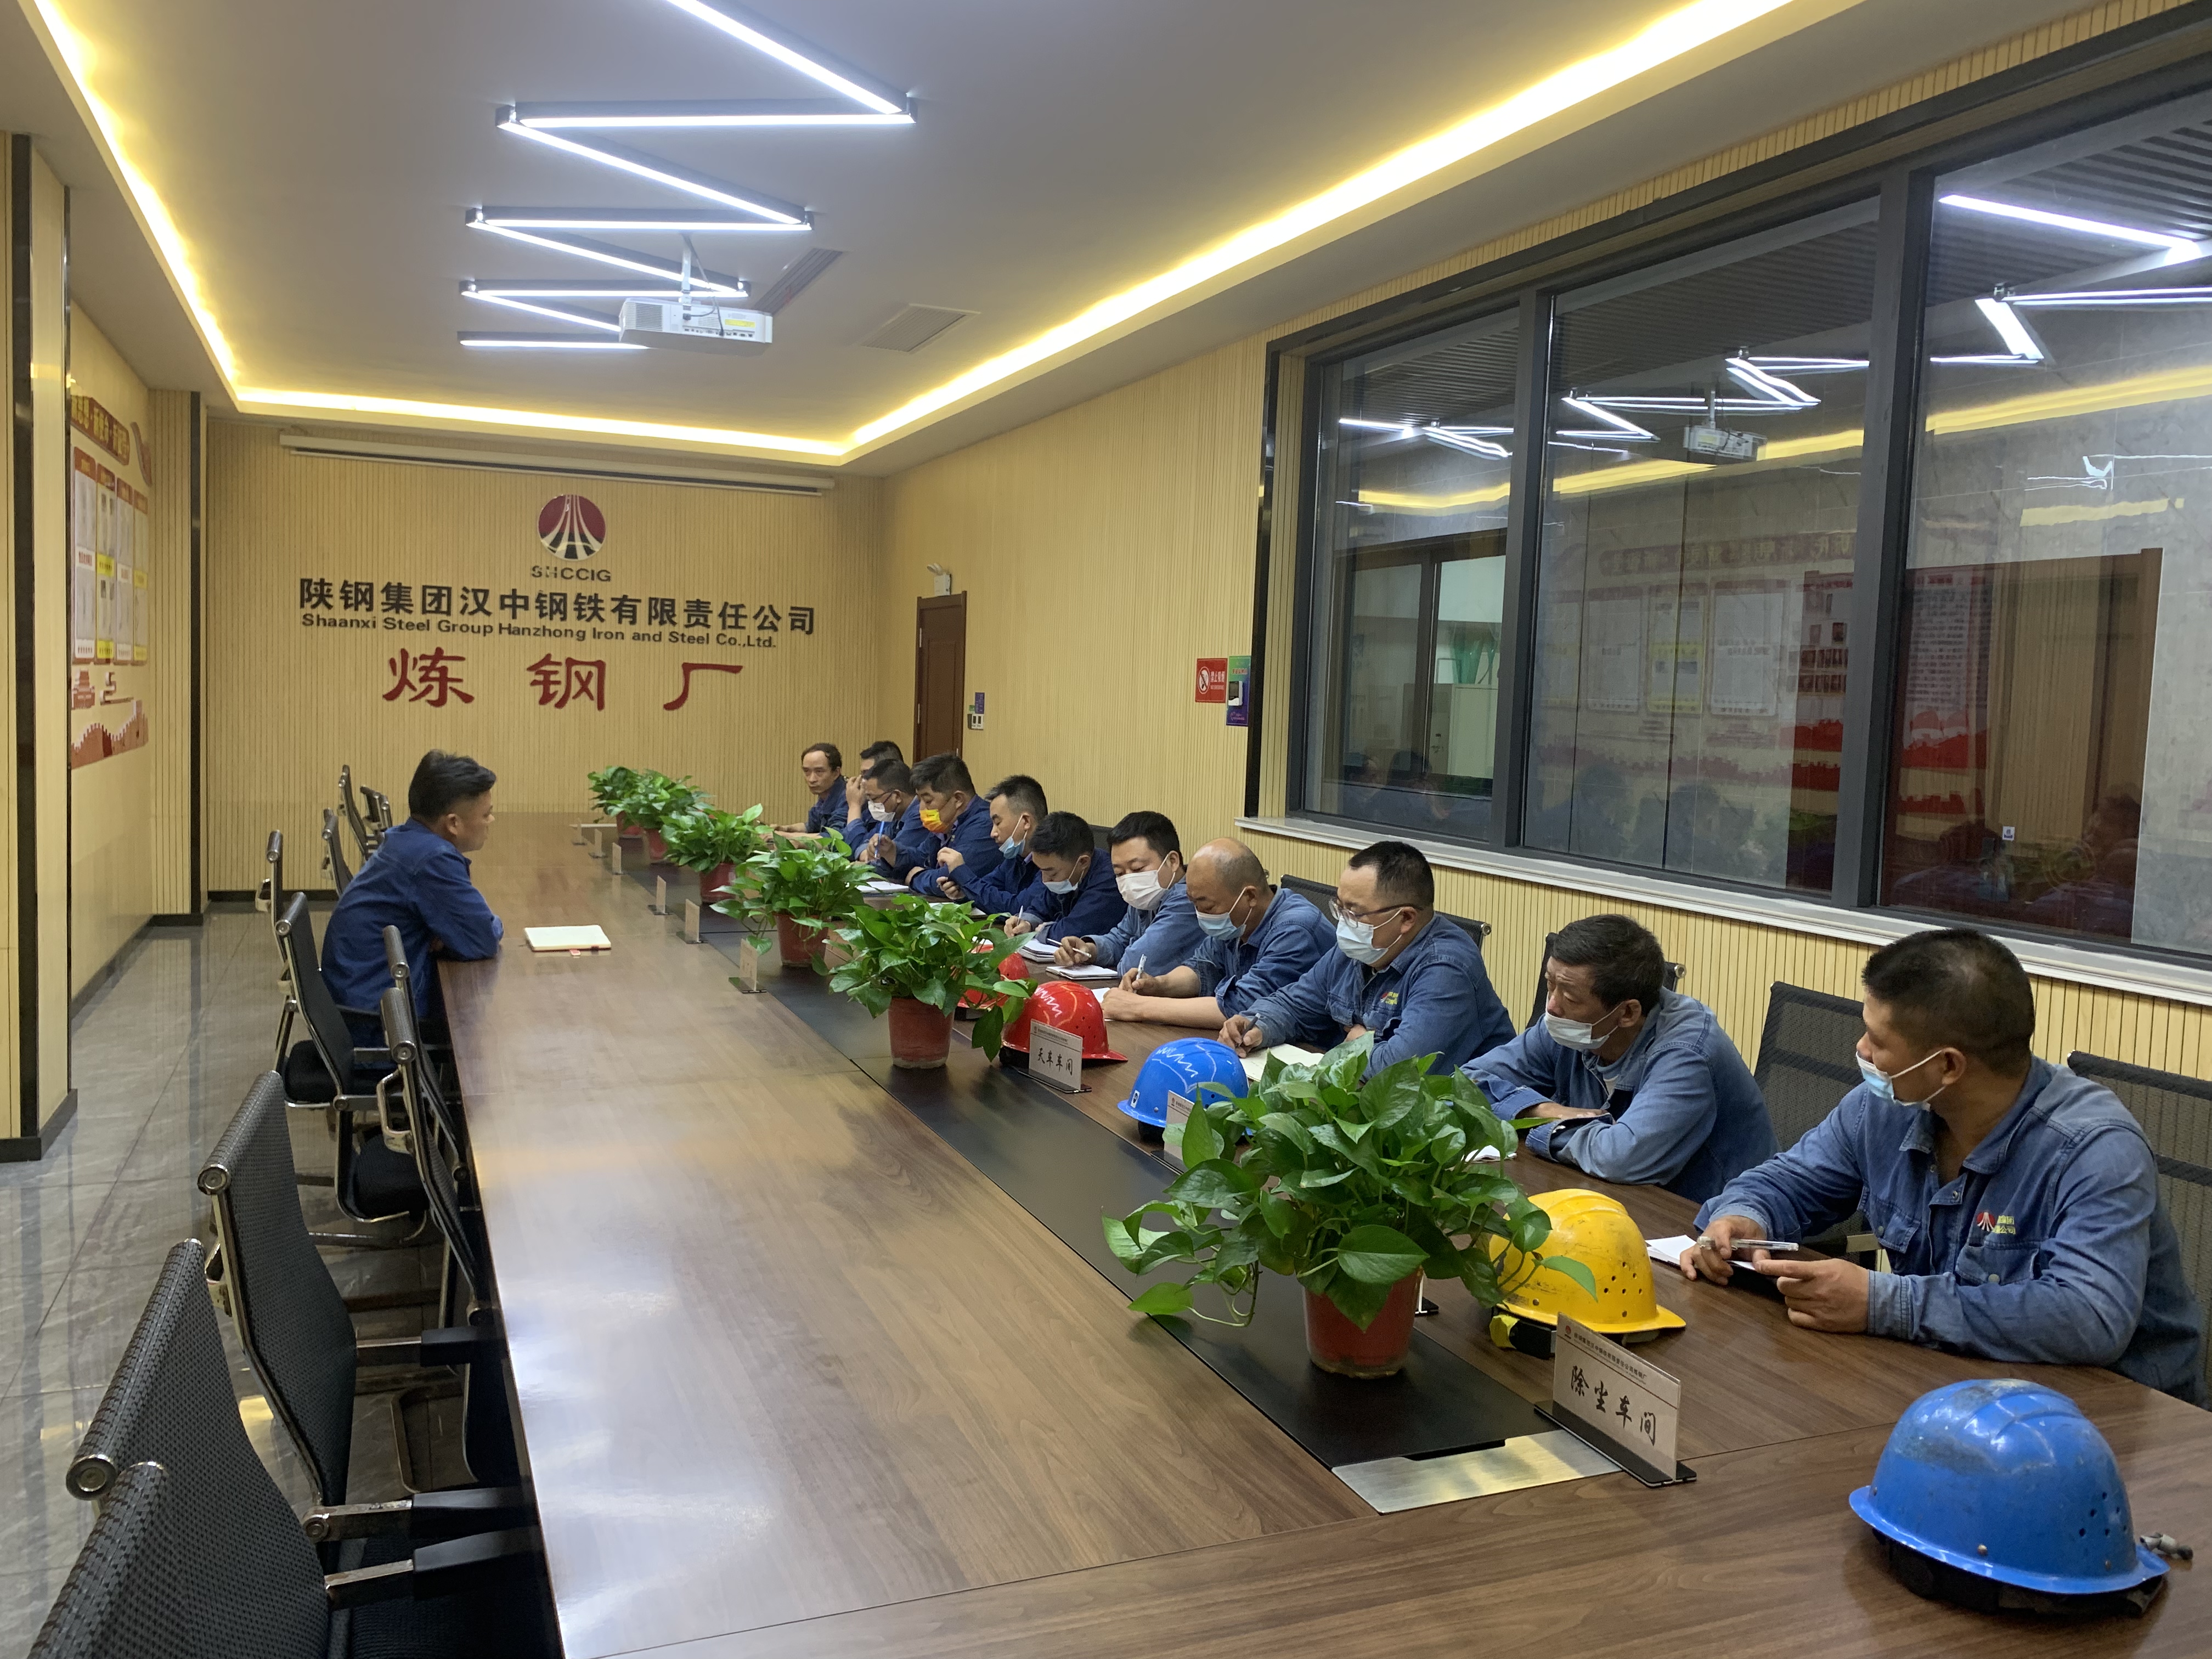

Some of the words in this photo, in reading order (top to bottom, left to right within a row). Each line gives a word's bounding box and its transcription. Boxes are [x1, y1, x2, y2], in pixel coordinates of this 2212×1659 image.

[532, 565, 611, 582] SHCCIG
[300, 578, 815, 635] 陕钢集团汉中钢铁有限责任公司
[302, 613, 376, 629] Shaanxi
[383, 617, 430, 631] Steel
[438, 619, 494, 637] Group
[499, 623, 586, 641] Hanzhong
[592, 627, 624, 640] Iron
[632, 631, 662, 642] and
[668, 631, 710, 645] Steel
[383, 646, 744, 712] 炼钢厂
[1037, 1047, 1073, 1076] 天车车间
[1571, 1365, 1656, 1446] 除尘车间
